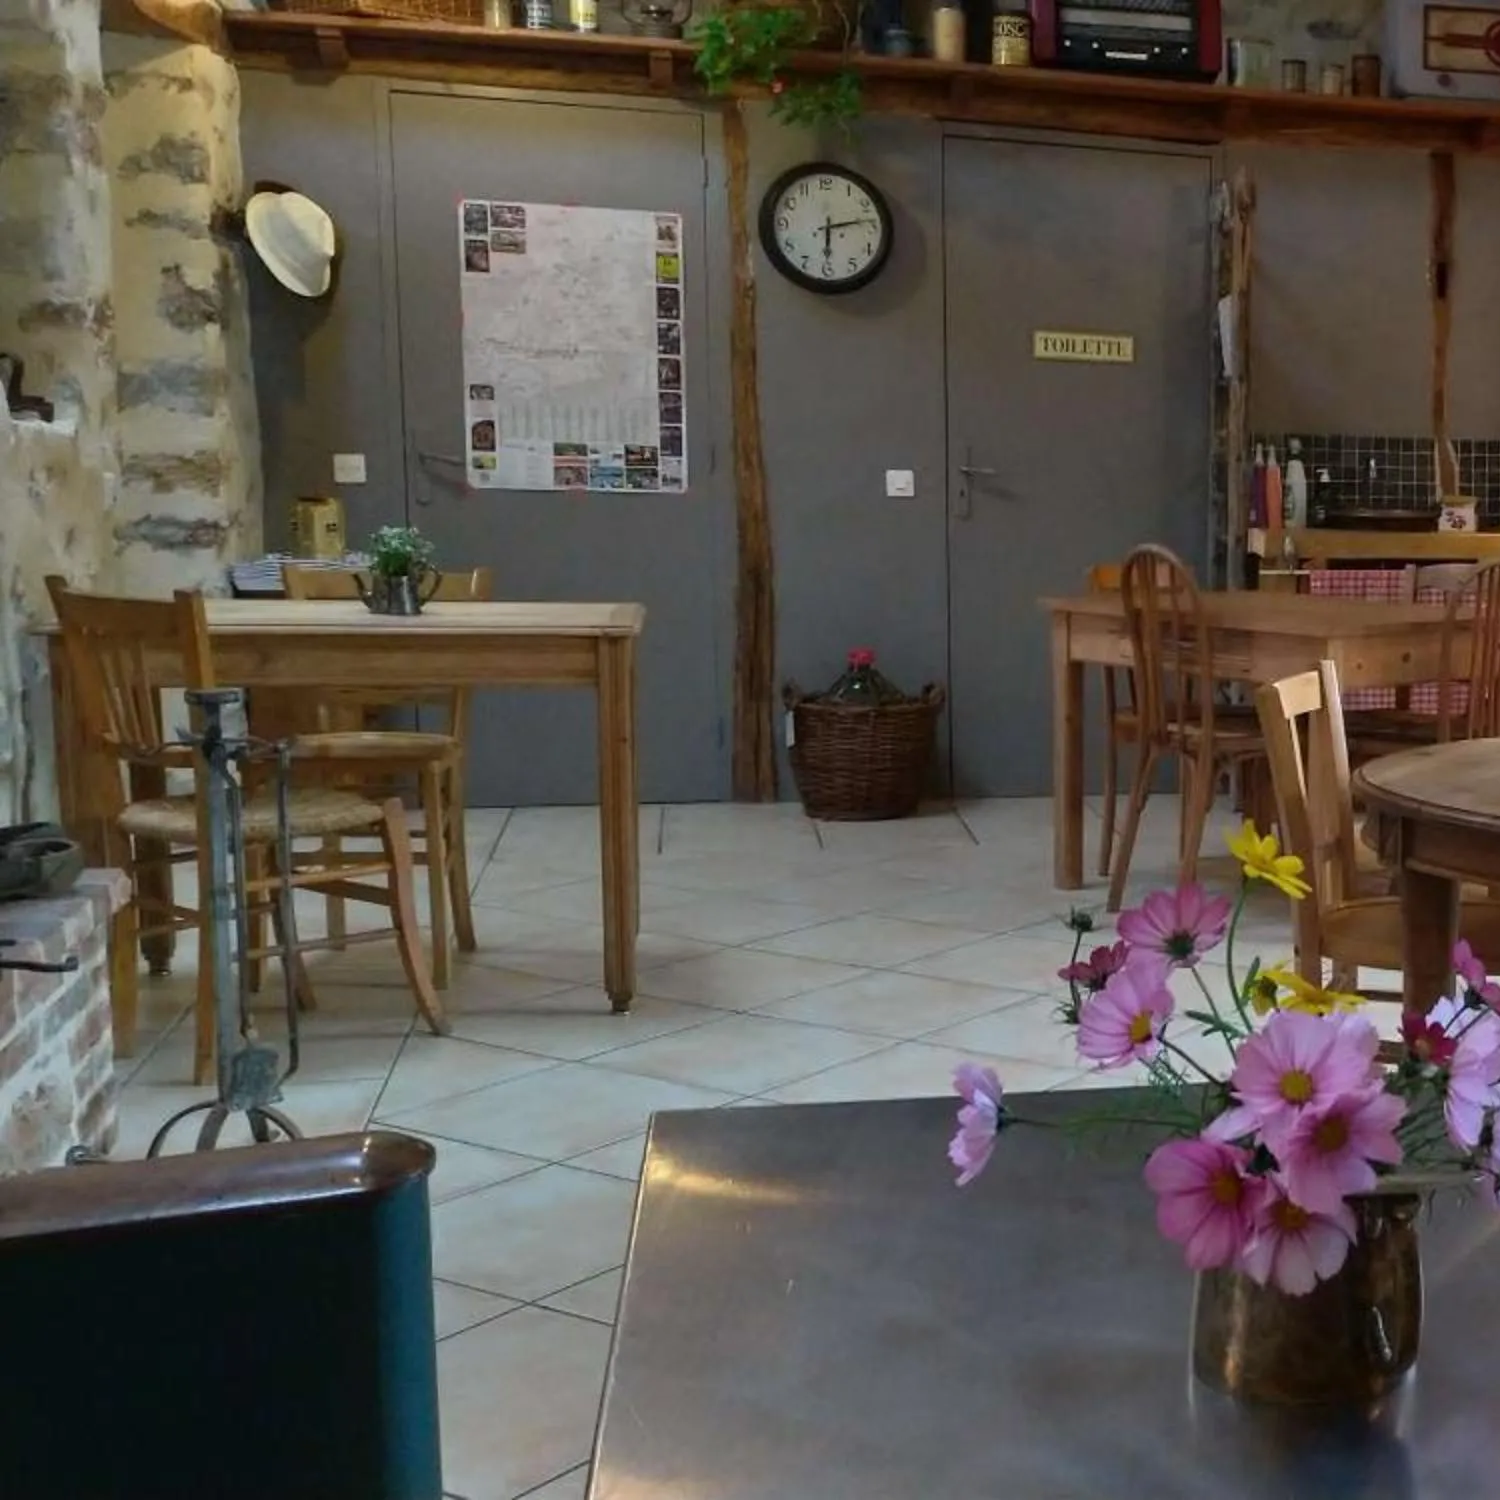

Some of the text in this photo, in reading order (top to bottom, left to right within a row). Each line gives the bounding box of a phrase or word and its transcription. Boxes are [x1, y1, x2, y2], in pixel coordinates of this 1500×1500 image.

[818, 177, 833, 191] 12
[860, 199, 871, 214] 2
[777, 216, 789, 232] 9
[800, 255, 810, 270] 7
[847, 257, 858, 274] 5
[1039, 335, 1129, 358] TOILETTE
